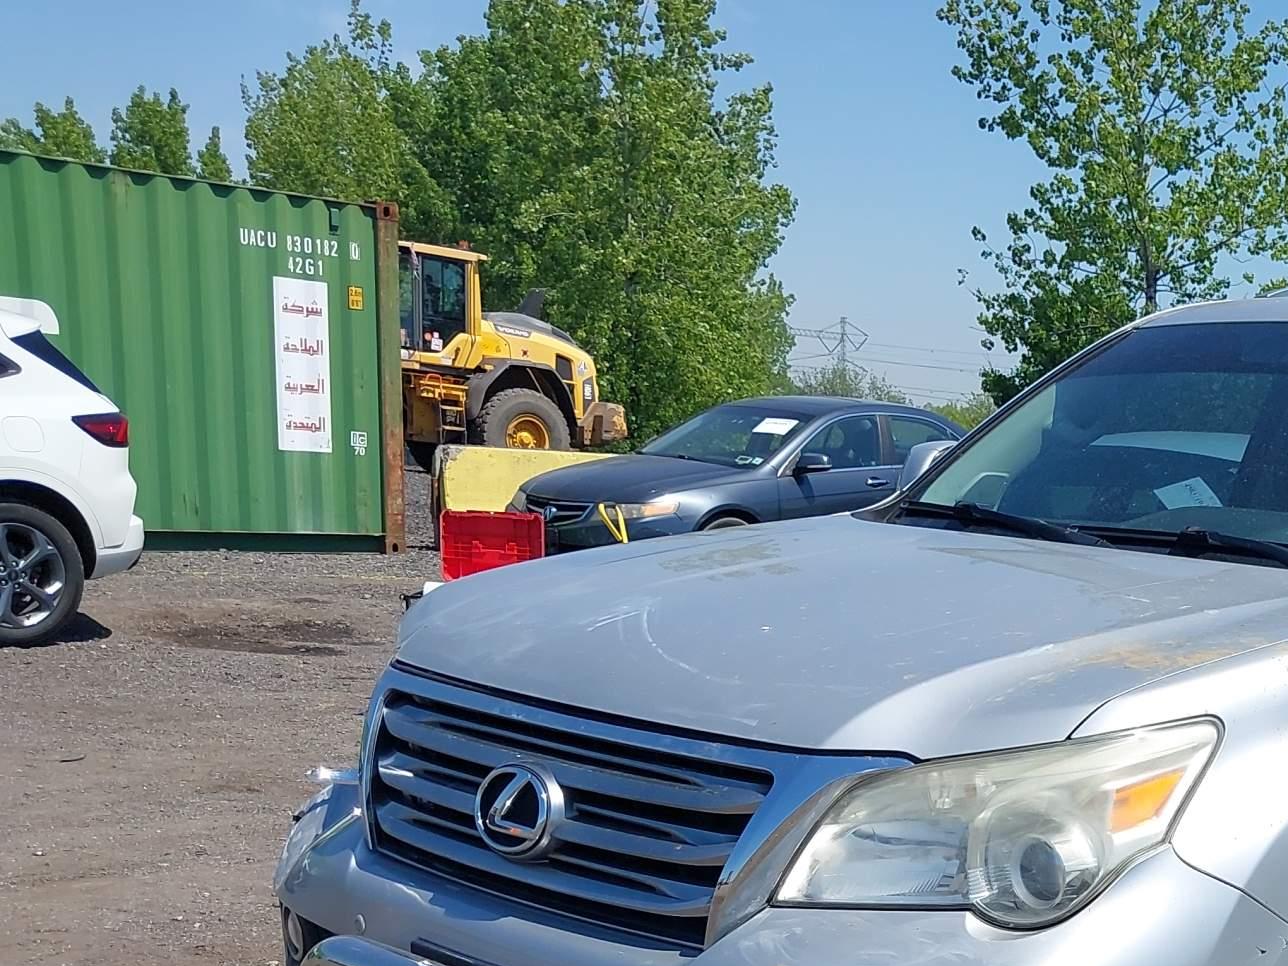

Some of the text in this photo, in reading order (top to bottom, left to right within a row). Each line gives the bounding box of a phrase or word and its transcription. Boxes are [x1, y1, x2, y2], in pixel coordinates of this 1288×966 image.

[240, 227, 277, 248] UACU
[286, 235, 339, 257] 830182
[287, 257, 323, 276] 42G1
[282, 296, 323, 318] شركة
[283, 336, 324, 357] الملاحة
[284, 375, 325, 395] العربية
[285, 414, 326, 433] المتحدة
[354, 447, 366, 456] 70
